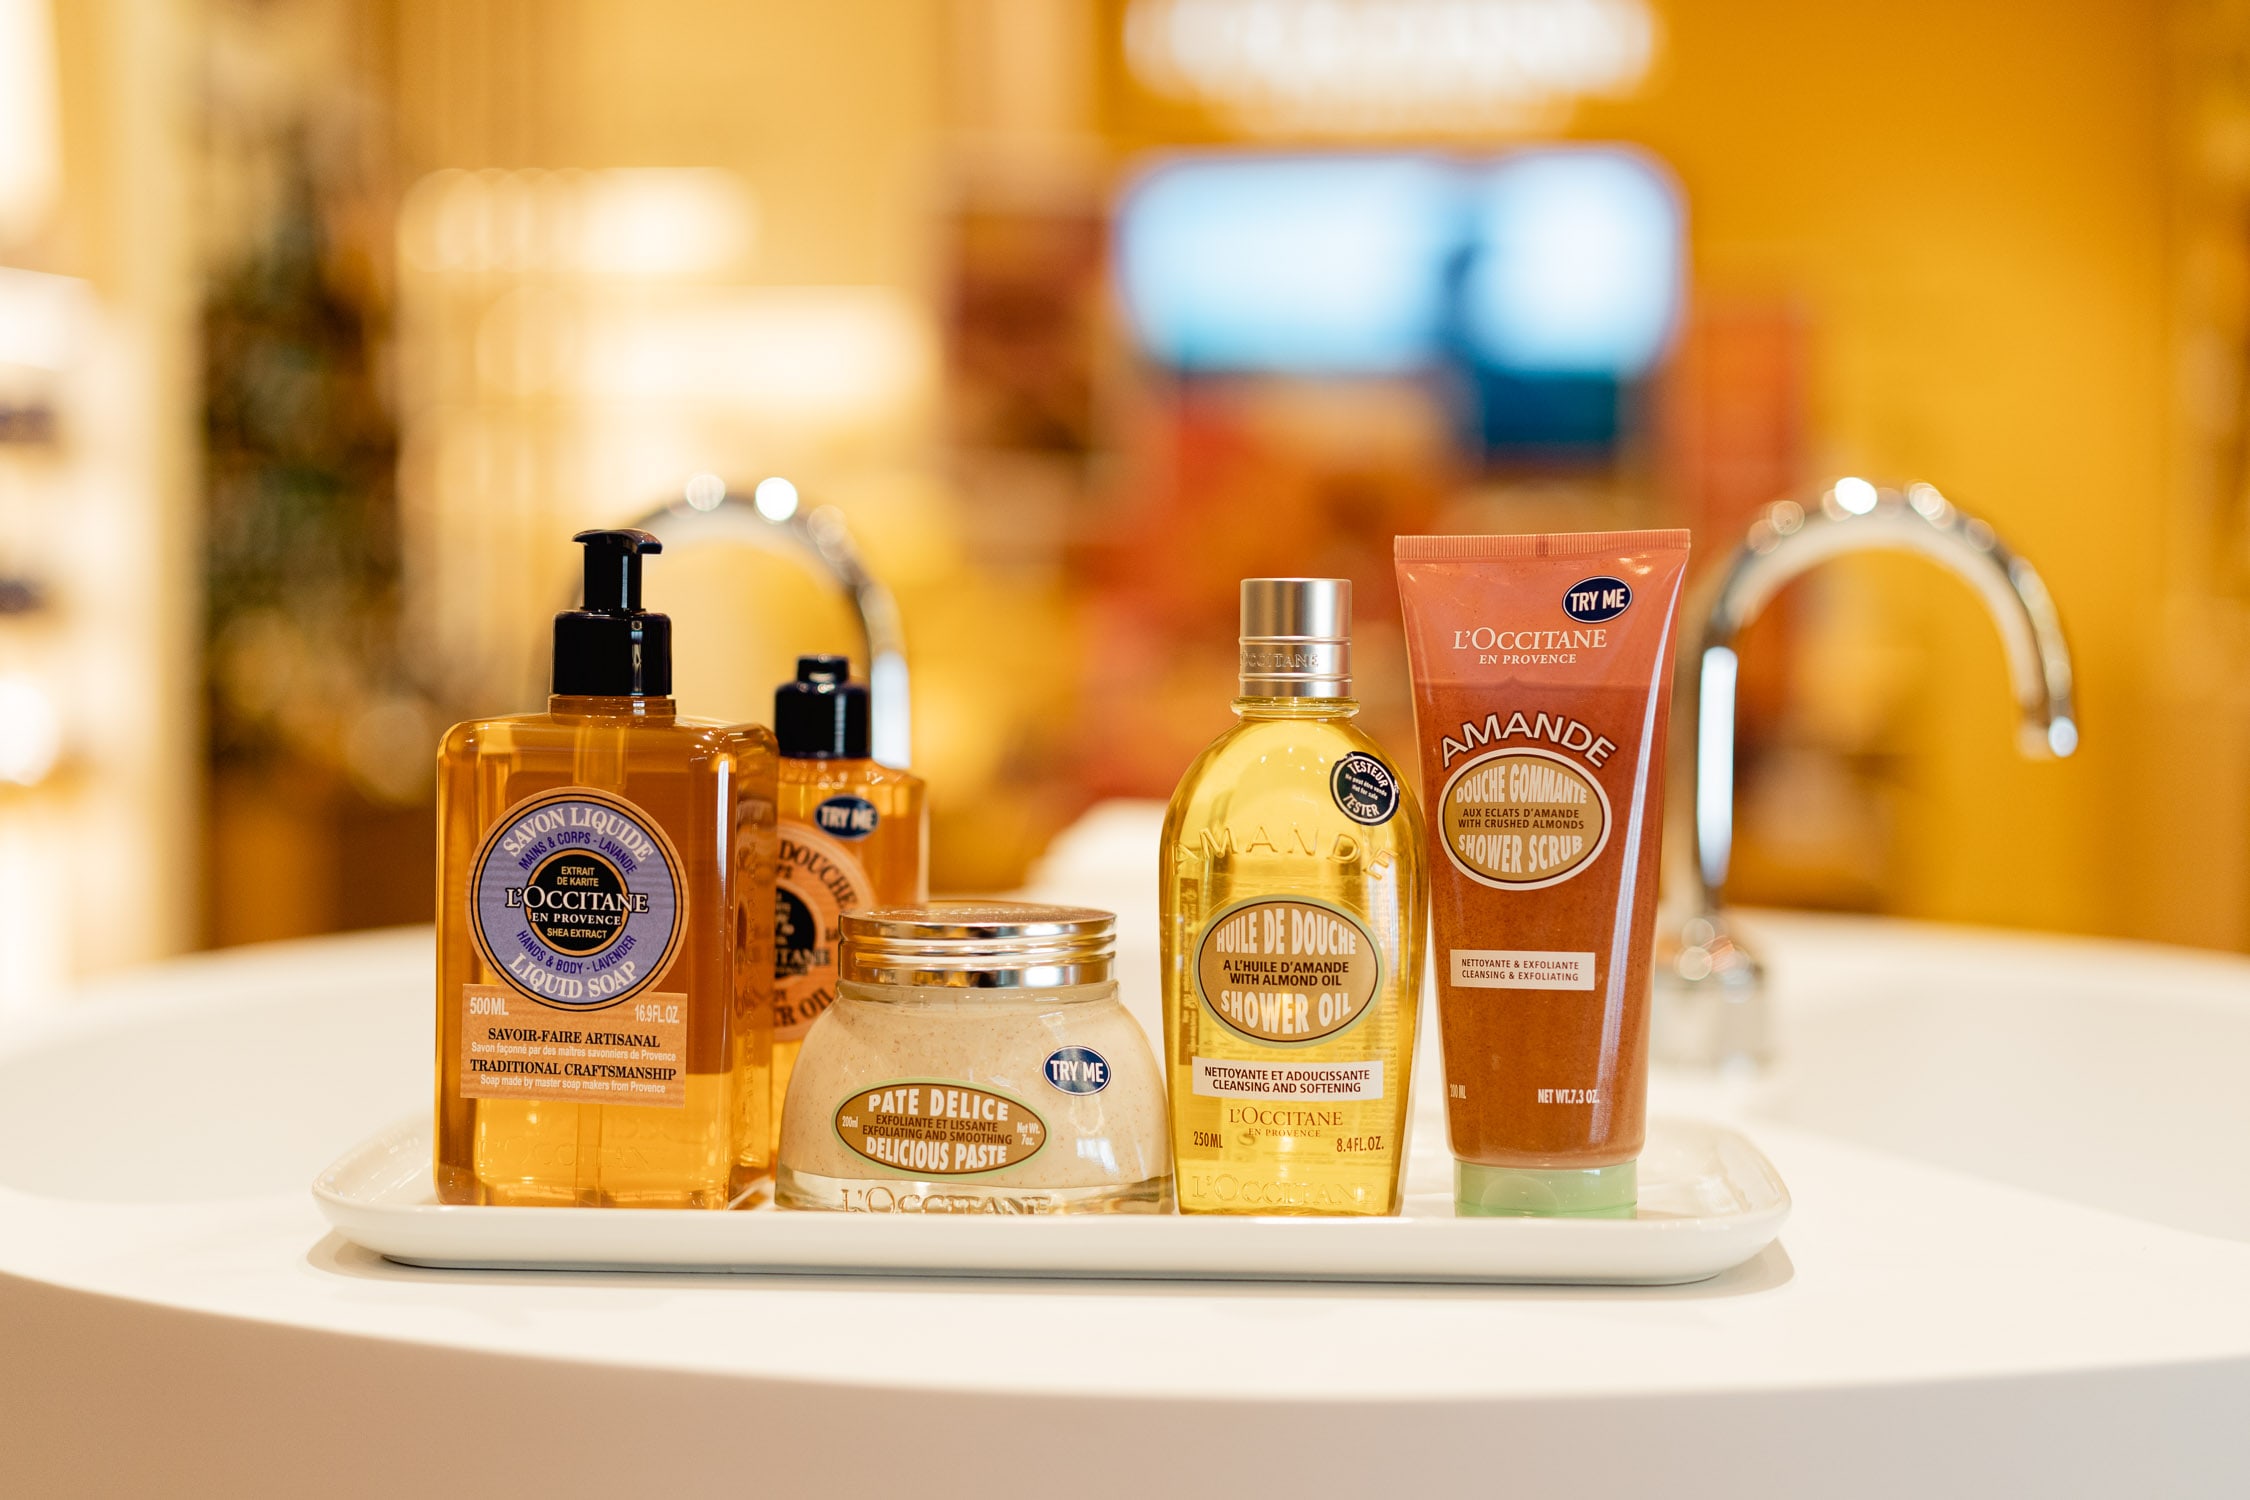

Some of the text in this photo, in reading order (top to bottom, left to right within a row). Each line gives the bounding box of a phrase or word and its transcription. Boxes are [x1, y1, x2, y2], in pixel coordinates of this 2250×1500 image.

[1570, 588, 1626, 612] TRY ME
[1453, 626, 1607, 650] L'OCCITANE
[1479, 654, 1576, 665] EN PROVENCE
[1442, 712, 1616, 768] AMANDE
[1347, 760, 1388, 788] TESTEUR
[1456, 764, 1587, 804] DOUCHE GOMMANTE
[1342, 792, 1380, 817] TESTER
[1462, 808, 1580, 819] AUX ECLATS D'AMANDE
[820, 806, 876, 831] TRY ME
[1458, 819, 1584, 830] WITH CRUSHED ALMONDS
[502, 806, 654, 862] SAVON LIQUIDE
[518, 840, 547, 870] MAINS
[548, 836, 556, 848] &
[557, 830, 591, 846] CORPS
[598, 838, 638, 875] LAVANDE
[1458, 834, 1584, 874] SHOWER SCRUB
[561, 866, 596, 876] EXTRAIT
[556, 876, 600, 888] DE KARITE
[505, 885, 649, 914] L'OCCITANE
[530, 912, 622, 926] EN PROVENCE
[546, 927, 608, 940] SHEA EXTRACT
[1216, 908, 1356, 956] HUILE DE DOUCHE
[516, 930, 544, 962] HANDS
[545, 955, 554, 968] &
[556, 958, 584, 974] BODY
[593, 934, 638, 972] LAVENDER
[1223, 960, 1350, 974] A L'HUILE D'AMANDE
[1462, 958, 1580, 970] NETTOYANTE & EXFOLIANTE
[508, 952, 638, 999] LIQUID SOAP
[1230, 973, 1342, 987] WITH ALMOND OIL
[1462, 970, 1578, 982] CLEANSING & EXFOLIATING
[470, 996, 510, 1016] 500ML
[1220, 990, 1351, 1035] SHOWER OIL
[488, 1028, 660, 1048] SAVOIR-FAIRE ARTISANAL
[471, 1041, 495, 1053] Savon
[528, 1046, 542, 1057] par
[542, 1045, 556, 1056] des
[587, 1048, 628, 1060] savonniers
[630, 1048, 640, 1060] de
[641, 1050, 676, 1062] Provence
[470, 1058, 677, 1081] TRADITIONAL CRAFTSMANSHIP
[1050, 1060, 1104, 1083] TRY ME
[1204, 1066, 1370, 1082] NETTOYANTE ET ADOUCISSANTE
[480, 1074, 666, 1094] Soap made by master soap makers from Provence
[1212, 1080, 1361, 1094] CLEANSING AND SOFTENING
[868, 1088, 1008, 1121] PATE DELICE
[1537, 1088, 1554, 1104] NET
[1586, 1089, 1600, 1104] OZ.
[876, 1114, 998, 1132] EXFOLIANTE ET LISSANTE
[1229, 1106, 1343, 1127] L'OCCITANE
[862, 1124, 1012, 1145] EXFOLIATING AND SMOOTHING
[1193, 1130, 1224, 1149] 250ML
[1248, 1128, 1320, 1138] EN PROVENCE
[866, 1136, 1007, 1170] DELICIOUS PASTE
